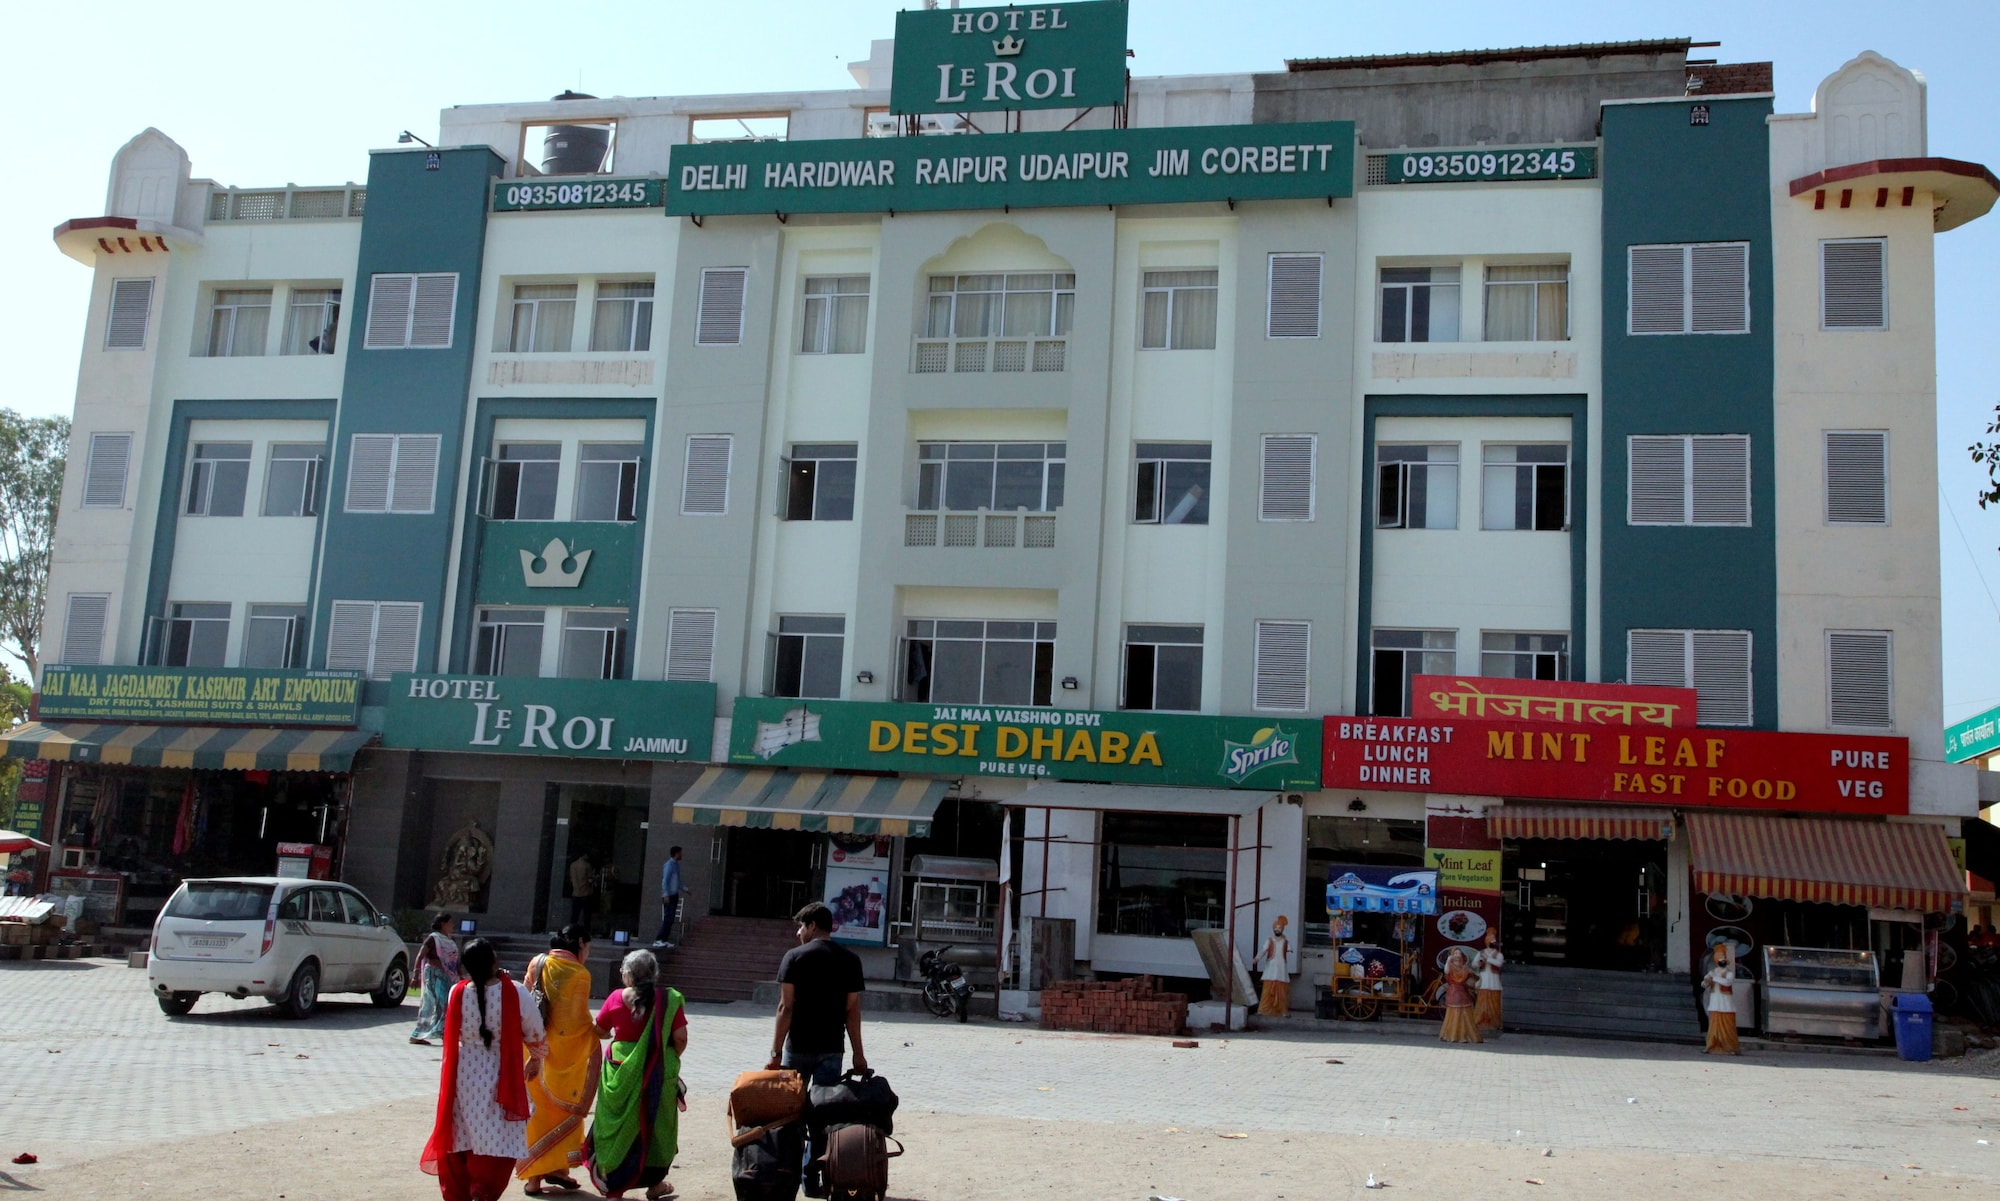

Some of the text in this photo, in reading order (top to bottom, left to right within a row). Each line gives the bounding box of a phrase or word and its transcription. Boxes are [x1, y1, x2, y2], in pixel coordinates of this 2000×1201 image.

[952, 9, 1067, 34] HOTEL
[982, 61, 1076, 101] ROI
[680, 144, 1333, 191] DELHI HARIDWAR RAIPUR UDAIPUR JIM CORBETT
[1402, 152, 1575, 177] 09350912345
[507, 183, 646, 205] 09350812345
[42, 673, 358, 703] JAI MAA JAGDAMBEY KASHMIR ART EMPORIUM
[408, 679, 500, 700] HOTEL
[89, 698, 302, 711] DRY FRUITS, KASHMIRI SUITS & SHAWLS
[1429, 681, 1680, 728] भोजनालय
[933, 707, 1101, 726] JAI MAA VAISHNO DEVI
[518, 704, 615, 750] ROI
[623, 737, 688, 754] JAMMU
[1340, 723, 1454, 743] BREAKFAST
[868, 720, 1163, 767] DESI DHABA
[1364, 745, 1428, 763] LUNCH
[1487, 730, 1726, 768] MINT LEAF
[1227, 736, 1289, 775] Sprite
[1831, 749, 1889, 770] PURE
[980, 761, 1051, 775] PURE VEG.
[1359, 765, 1431, 785] DINNER
[1613, 772, 1796, 801] FAST FOOD
[1837, 779, 1884, 798] VEG
[1439, 858, 1493, 871] Mint Leaf
[1457, 873, 1493, 883] Vegetarian
[1443, 896, 1482, 908] Indian
